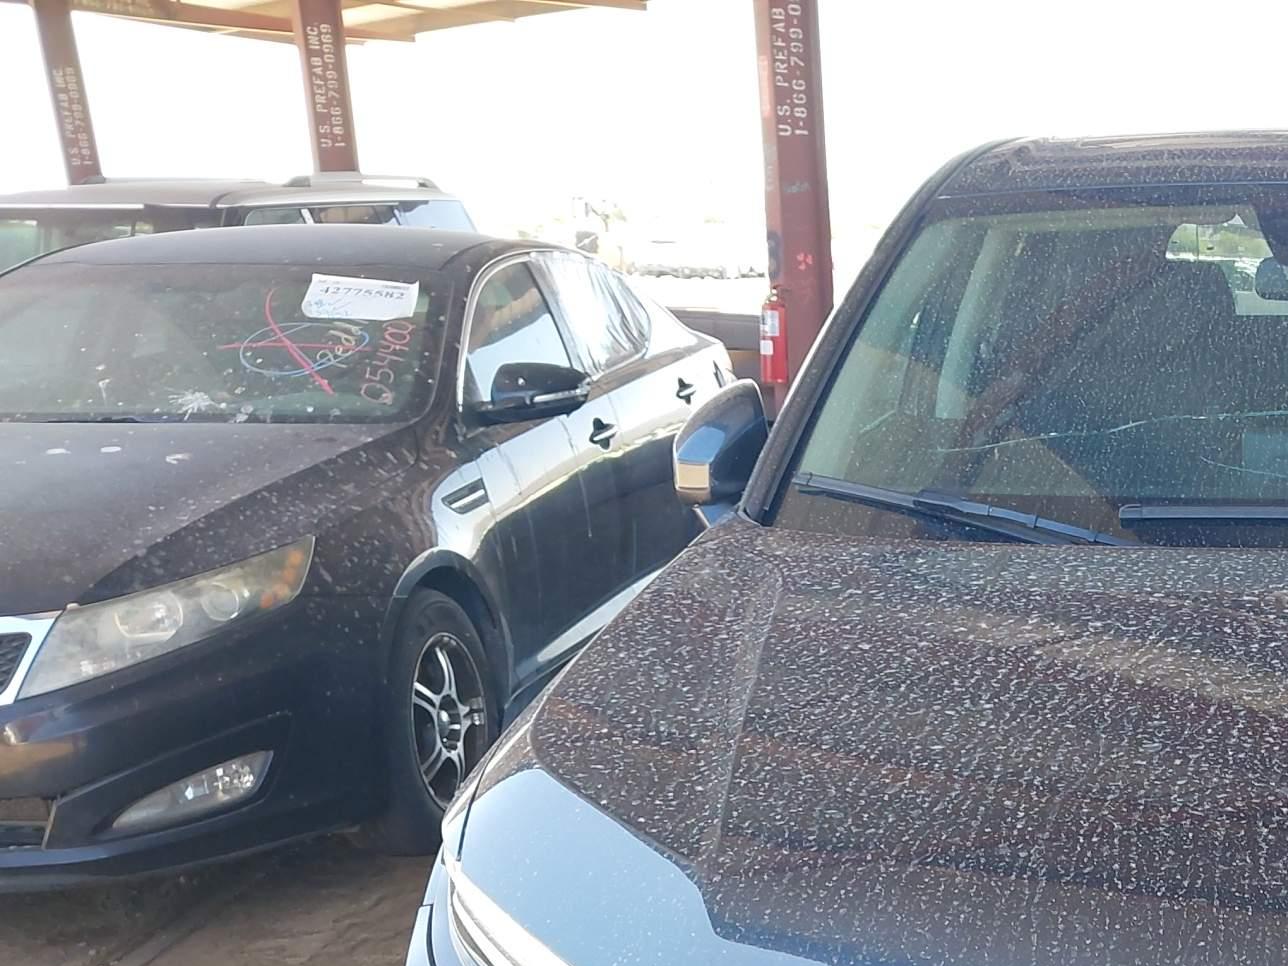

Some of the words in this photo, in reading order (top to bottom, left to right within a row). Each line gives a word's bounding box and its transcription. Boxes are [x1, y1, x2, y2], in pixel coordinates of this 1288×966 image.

[310, 56, 328, 112] PREFAB
[771, 8, 789, 87] PREFAB
[787, 0, 809, 136] 1-866-799-0
